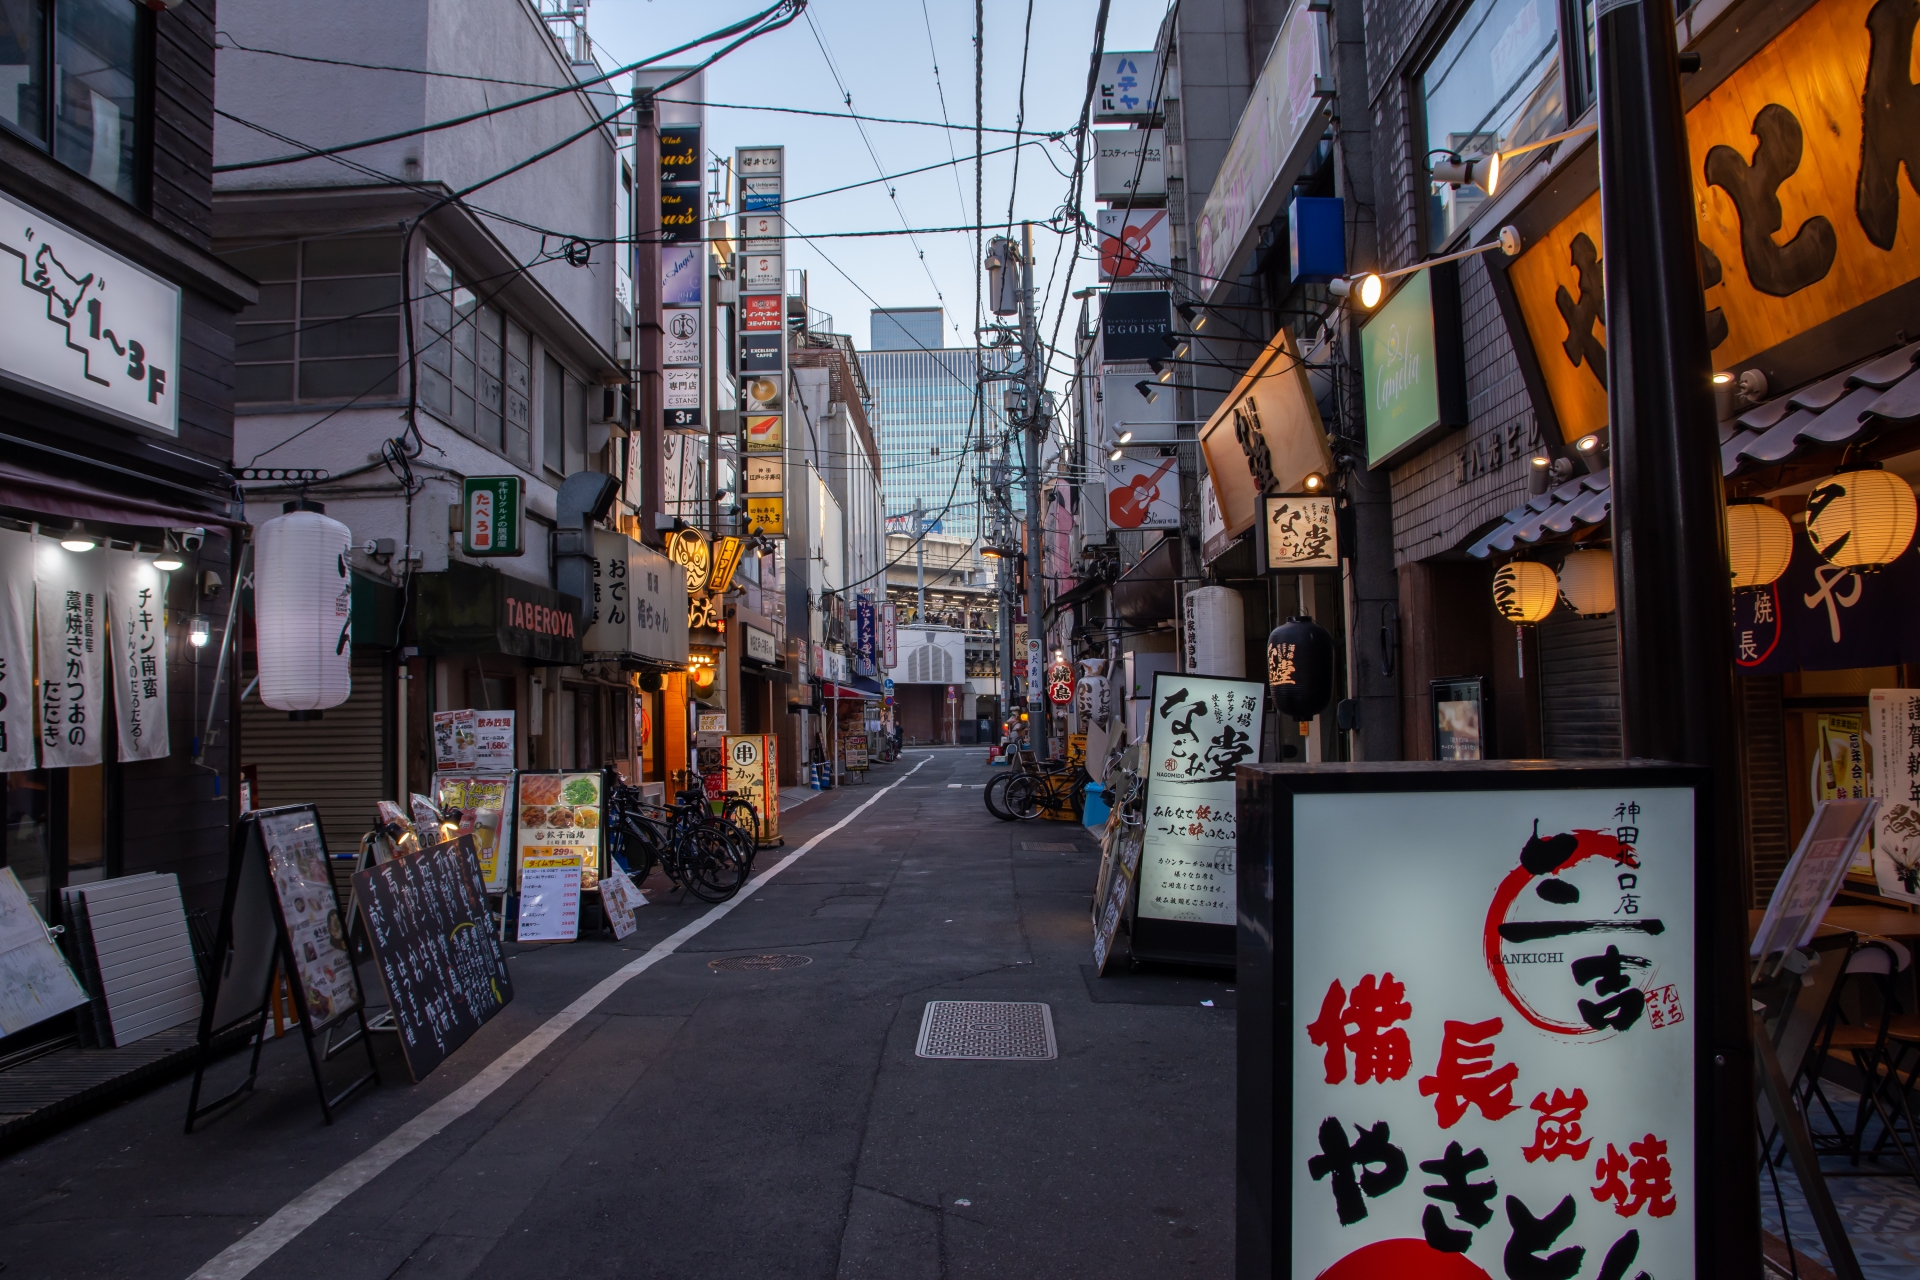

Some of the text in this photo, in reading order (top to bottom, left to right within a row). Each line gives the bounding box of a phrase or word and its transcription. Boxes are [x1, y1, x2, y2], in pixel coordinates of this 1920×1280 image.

[1101, 83, 1115, 110] ビル
[1116, 58, 1139, 109] ハチヤ
[661, 136, 681, 144] Club
[661, 195, 681, 203] Club
[741, 190, 746, 200] 6
[740, 268, 746, 279] 4
[741, 308, 747, 318] 3
[1107, 324, 1167, 334] EGOIST
[741, 349, 747, 359] 2
[741, 389, 747, 399] 2
[675, 411, 693, 424] 3F
[474, 493, 490, 546] たべろ屋
[496, 480, 508, 548] 手作りグルメの居酒屋
[608, 558, 626, 625] おでん
[85, 592, 94, 653] 鹿児島産
[506, 597, 575, 639] TABEROYA
[138, 588, 158, 699] チキン南蛮
[1052, 665, 1071, 701] 焼鳥
[42, 679, 61, 748] たたき
[477, 717, 511, 728] 飲み放題
[1236, 695, 1258, 729] 酒場
[736, 744, 753, 763] 串
[441, 781, 467, 809] 酒
[528, 858, 576, 867] タイムサービス
[1613, 800, 1641, 915] 神田北口店
[1492, 951, 1565, 965] SANKICHI
[1306, 971, 1678, 1220] 備長炭焼
